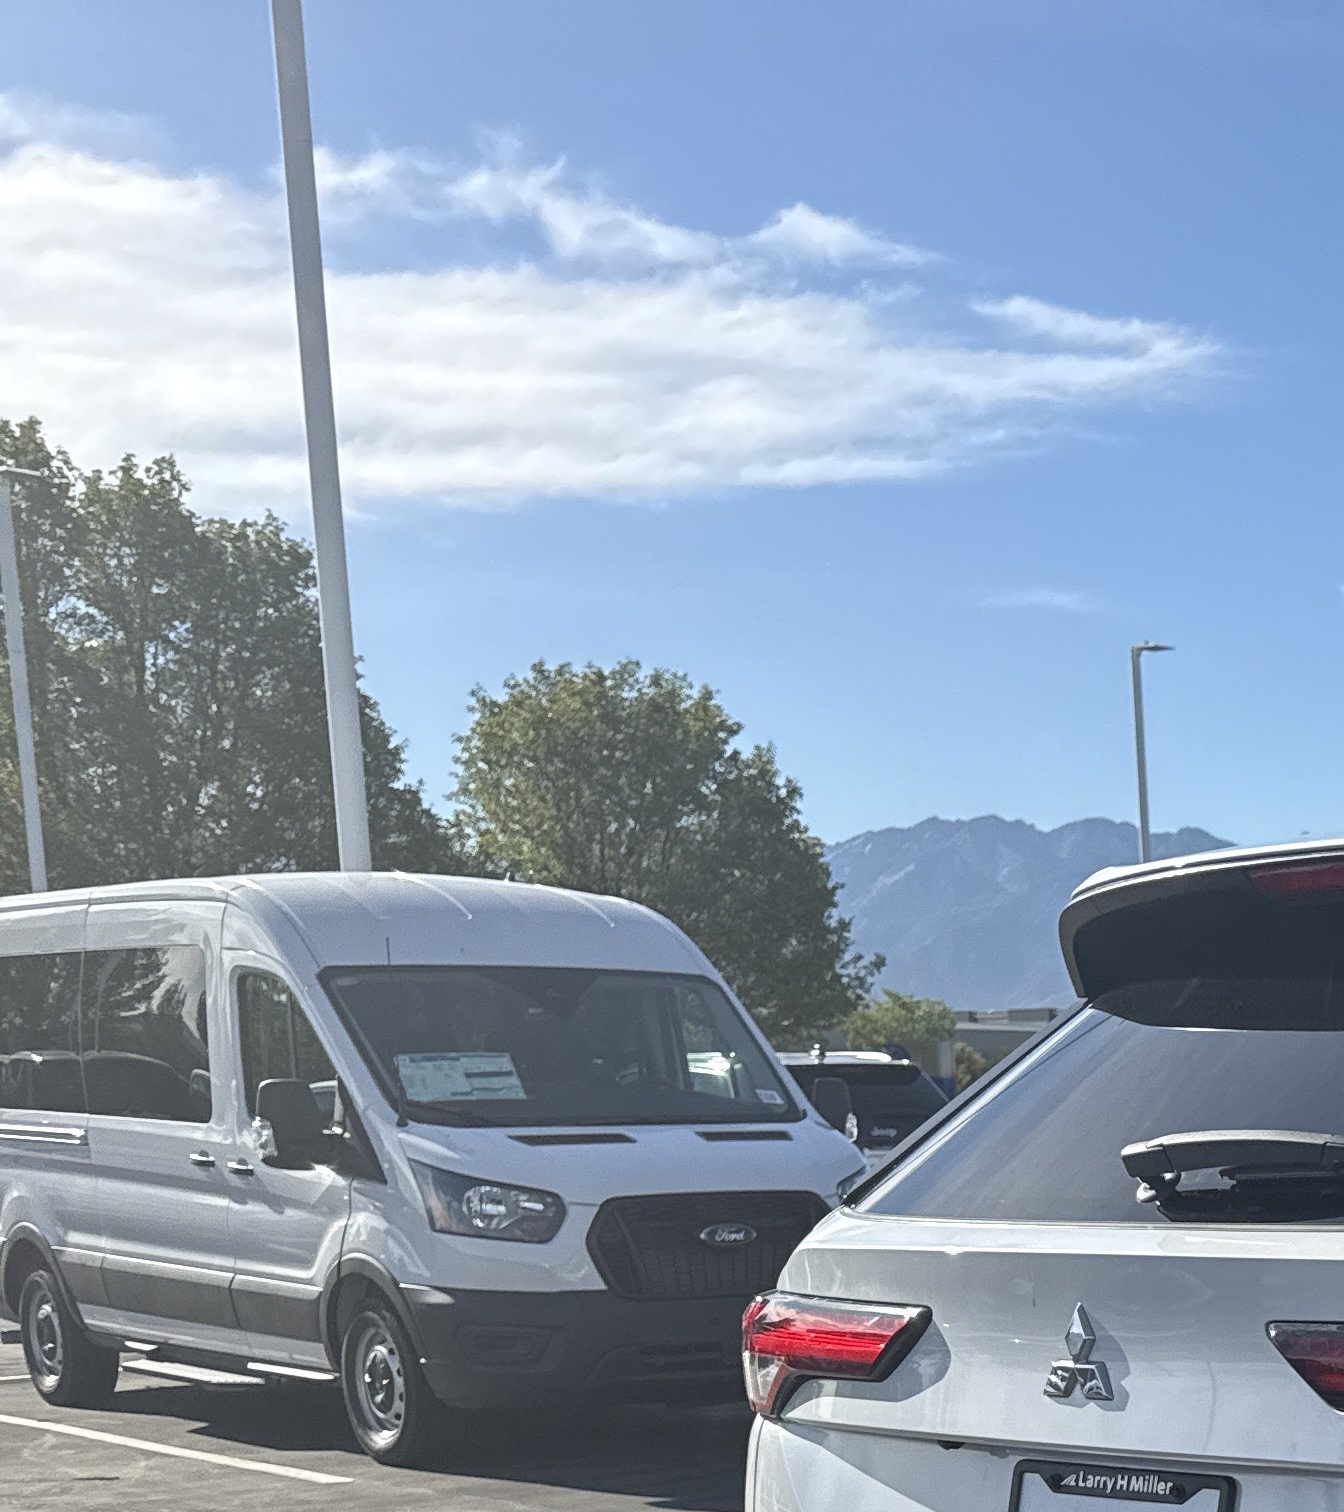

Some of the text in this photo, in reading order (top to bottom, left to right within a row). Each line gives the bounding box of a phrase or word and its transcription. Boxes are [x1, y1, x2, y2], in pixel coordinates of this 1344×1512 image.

[1078, 1471, 1173, 1495] Larry H Miller
